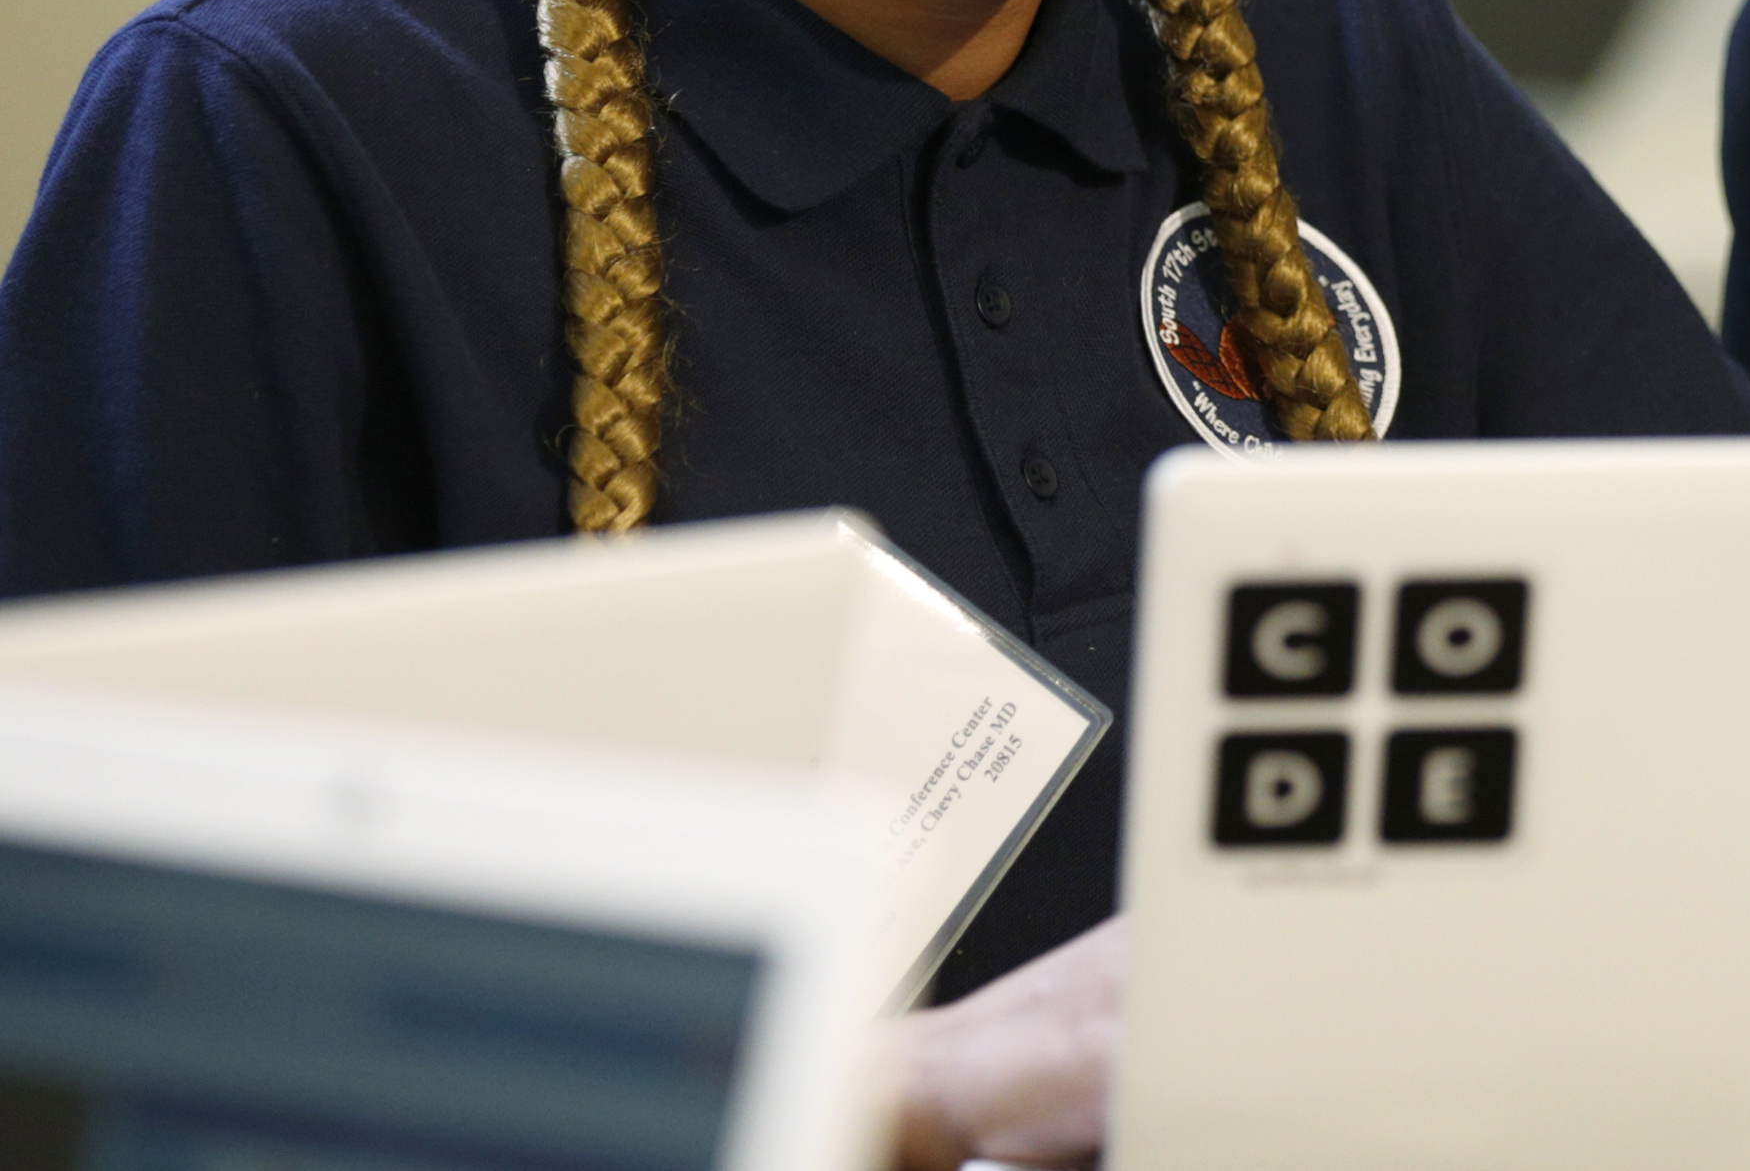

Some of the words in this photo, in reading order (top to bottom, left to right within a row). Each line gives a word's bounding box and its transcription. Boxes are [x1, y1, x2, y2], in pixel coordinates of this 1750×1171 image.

[1161, 240, 1198, 284] 17th
[1190, 227, 1218, 253] St
[1157, 283, 1180, 346] South
[1330, 279, 1378, 363] Everyday
[1193, 391, 1241, 445] Where
[888, 750, 956, 837] Conference
[951, 695, 994, 750] Center
[920, 782, 962, 833] Chevy
[955, 734, 996, 782] Chase
[988, 701, 1018, 736] MD
[983, 733, 1024, 784] 20815
